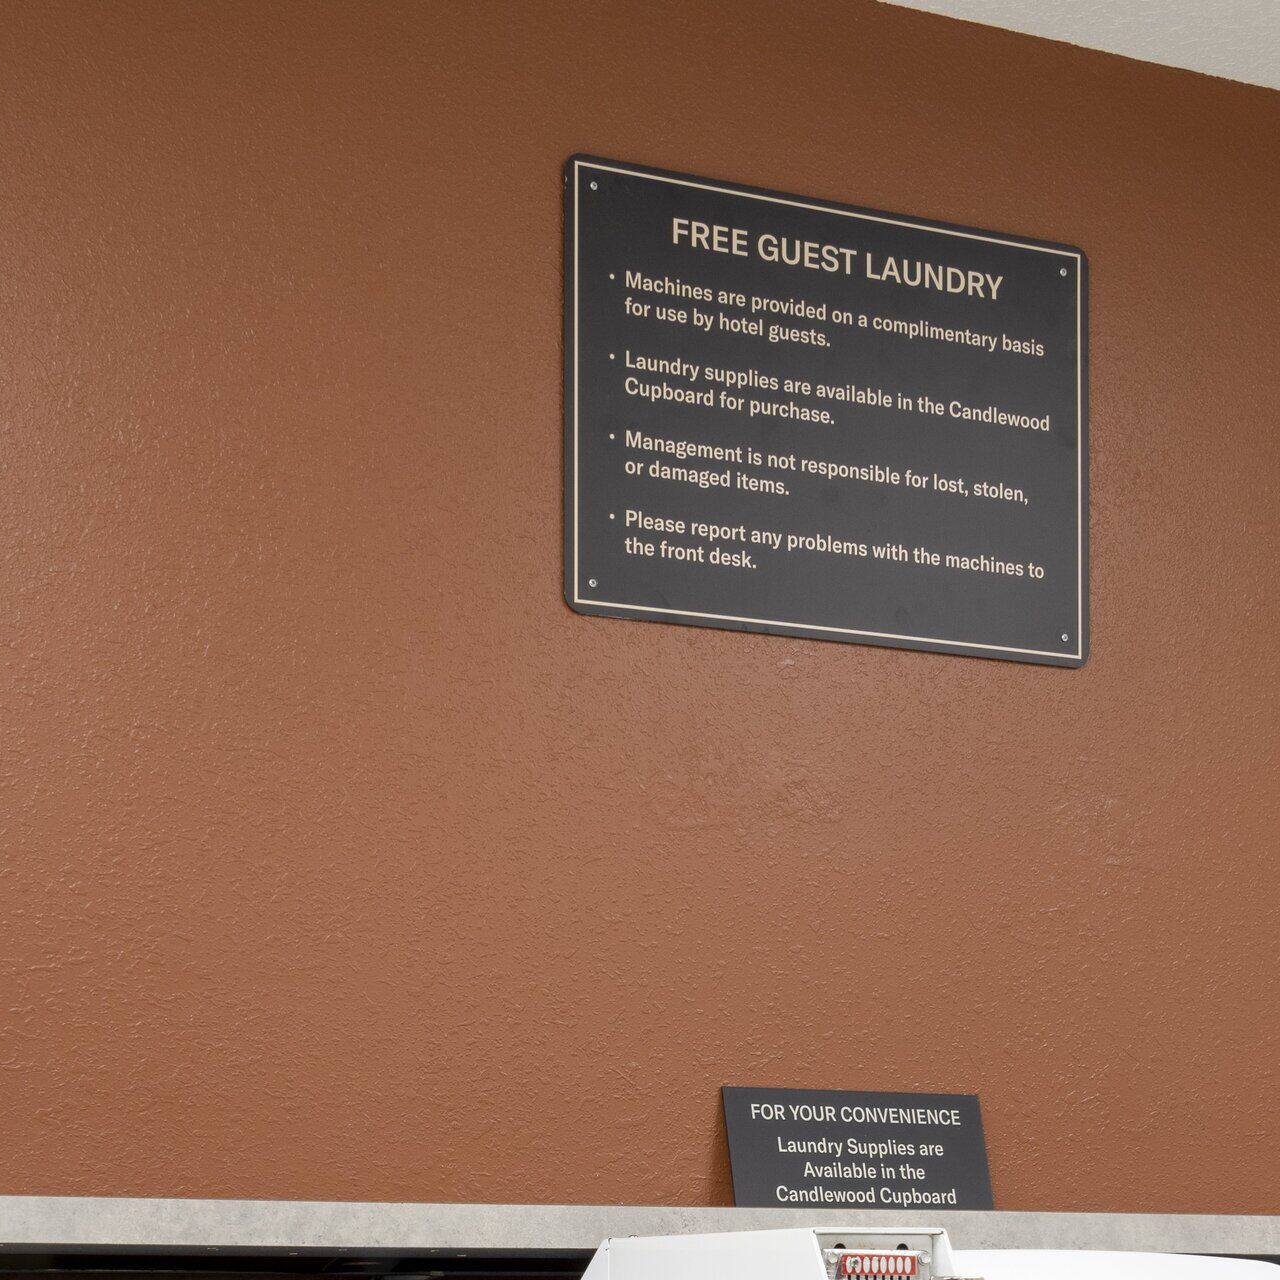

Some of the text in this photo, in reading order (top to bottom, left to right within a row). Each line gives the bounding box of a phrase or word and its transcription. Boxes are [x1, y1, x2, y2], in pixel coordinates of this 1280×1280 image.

[673, 218, 1003, 300] FREE GUEST LAUNDRY
[625, 297, 830, 347] for use by hotel guests.
[626, 270, 1044, 356] Machines are provided on a complimentary basis
[625, 377, 834, 424] Cupboard for purchase.
[626, 350, 1049, 431] Laundry supplies are available in the Candlewood
[625, 460, 789, 495] or damaged items.
[626, 430, 1028, 505] Management is not responsible for lost, stolen,
[624, 537, 756, 569] the front desk.
[626, 509, 1044, 579] Please report any problems with the machines to
[751, 1104, 961, 1125] FOR YOUR CONVENIENCE
[777, 1136, 944, 1158] Laundry Supplies are
[804, 1162, 925, 1180] Available in the
[776, 1185, 957, 1207] Candlewood Cupboard
